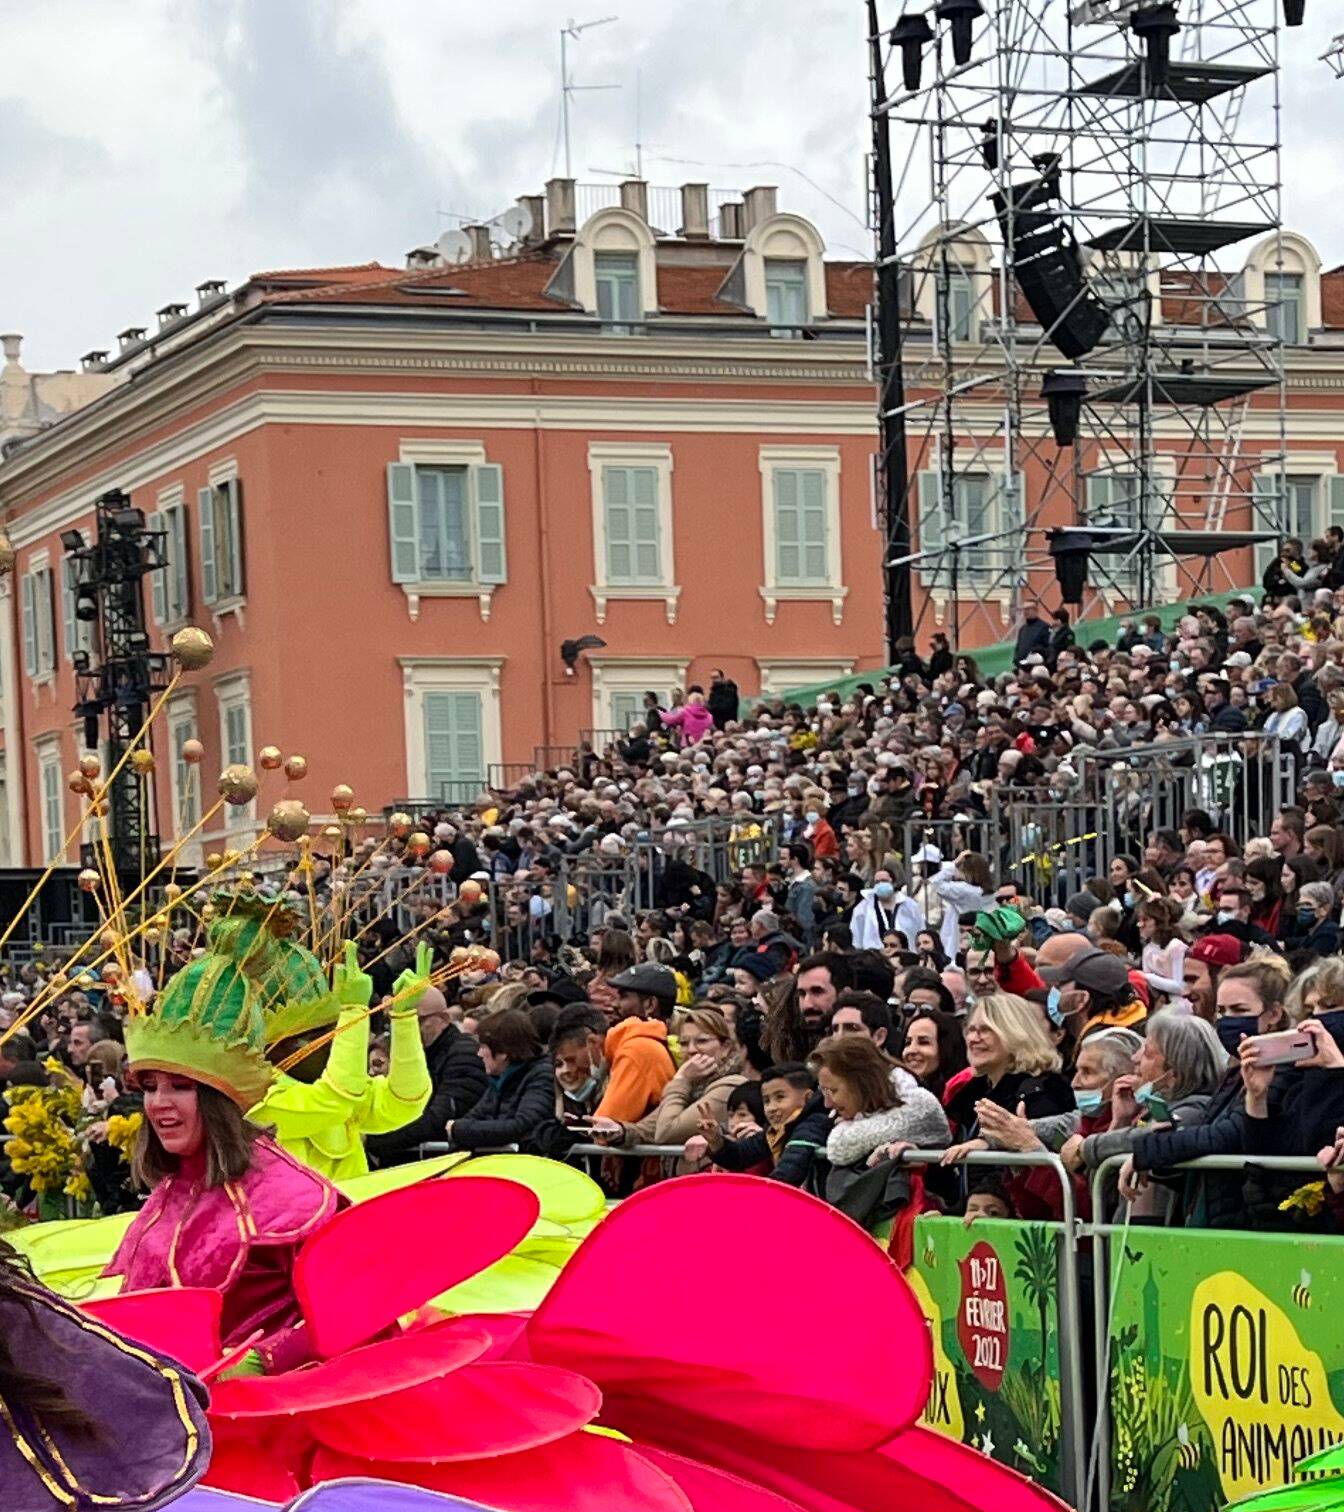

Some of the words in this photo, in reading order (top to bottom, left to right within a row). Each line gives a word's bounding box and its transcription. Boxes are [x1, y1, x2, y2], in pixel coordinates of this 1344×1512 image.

[965, 1290, 1007, 1335] FÉVRIER
[971, 1334, 1003, 1371] 2022
[1202, 1302, 1269, 1405] ROI
[1278, 1364, 1313, 1409] DES
